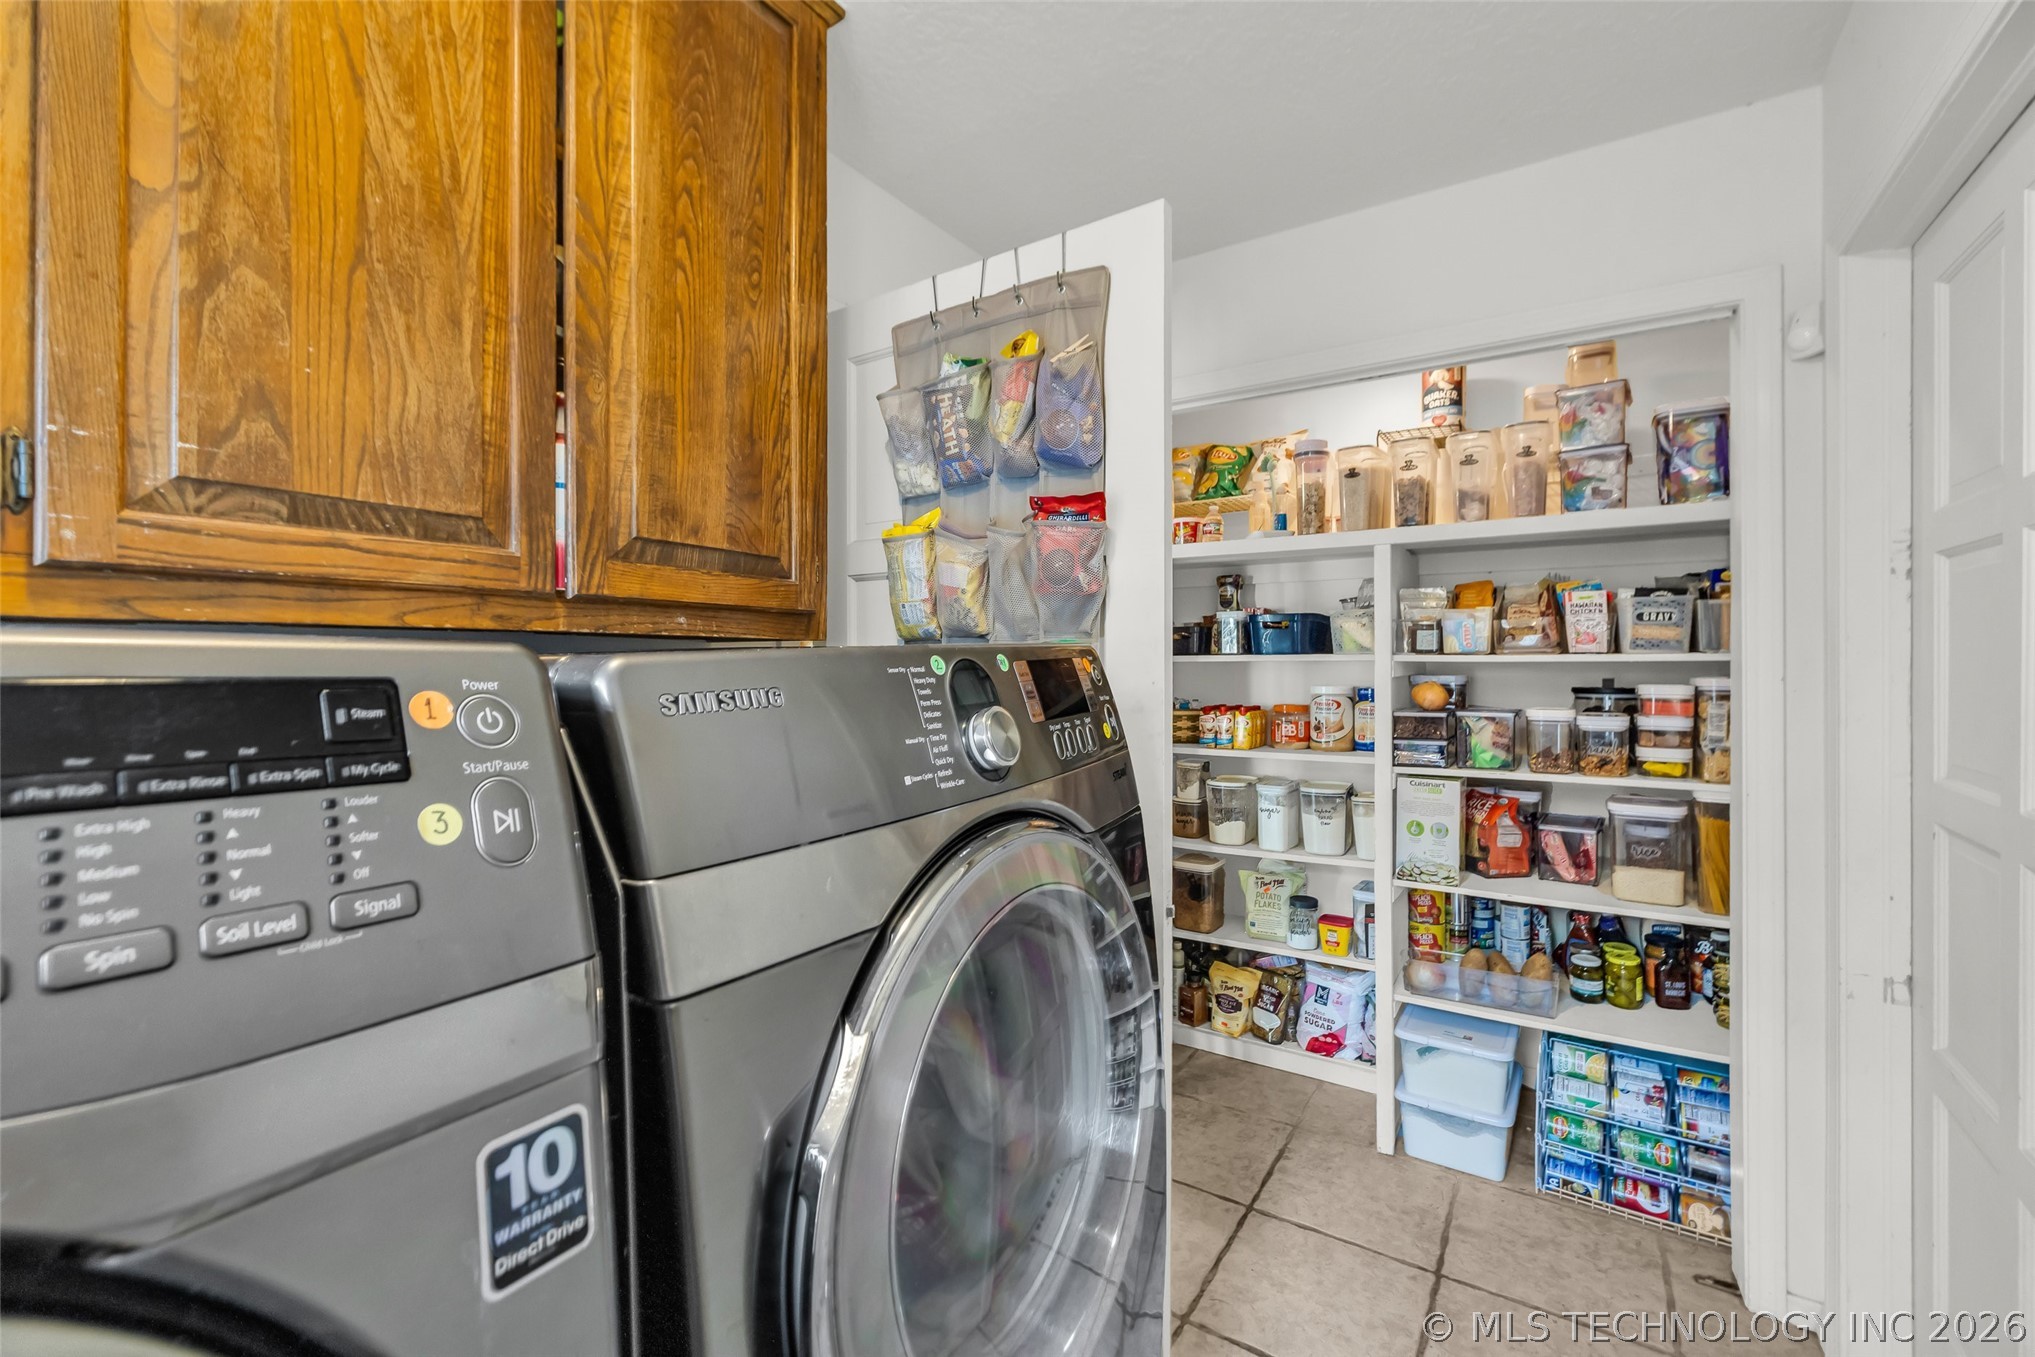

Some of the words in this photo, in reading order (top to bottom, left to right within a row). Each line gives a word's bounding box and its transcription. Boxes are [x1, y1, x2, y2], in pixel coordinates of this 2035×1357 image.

[1424, 389, 1458, 405] QUAKER
[1429, 398, 1450, 409] OATS
[941, 392, 960, 456] HEATH
[1642, 611, 1676, 621] GRAVY
[935, 660, 942, 670] 2
[461, 679, 499, 690] Power
[424, 697, 437, 720] 1
[659, 686, 784, 717] SAMSUNG
[350, 708, 387, 719] Steam
[350, 764, 370, 777] My
[370, 761, 401, 776] Cycle
[462, 759, 529, 775] Start/Pause
[938, 769, 953, 777] Refresh
[259, 771, 293, 783] Extra
[293, 768, 323, 781] Spin
[1409, 780, 1446, 789] Cuisinart
[343, 794, 379, 808] Louder
[222, 806, 261, 819] Heavy
[431, 810, 449, 834] 3
[348, 830, 379, 843] Softer
[225, 843, 272, 861] Normal
[1632, 845, 1662, 858] rice
[352, 865, 370, 880] Off
[228, 884, 262, 903] Light
[1255, 891, 1282, 901] POTATO
[353, 893, 402, 918] Signal
[1254, 900, 1282, 911] FLAKES
[215, 921, 250, 946] Soil
[253, 913, 298, 938] Level
[83, 945, 137, 974] Spin
[1303, 1016, 1333, 1031] SUGAR
[1304, 1010, 1336, 1025] POWDERED
[494, 1125, 578, 1211] 10
[494, 1186, 584, 1247] WARRANTY
[494, 1235, 544, 1278] Direct
[545, 1215, 587, 1246] Drive
